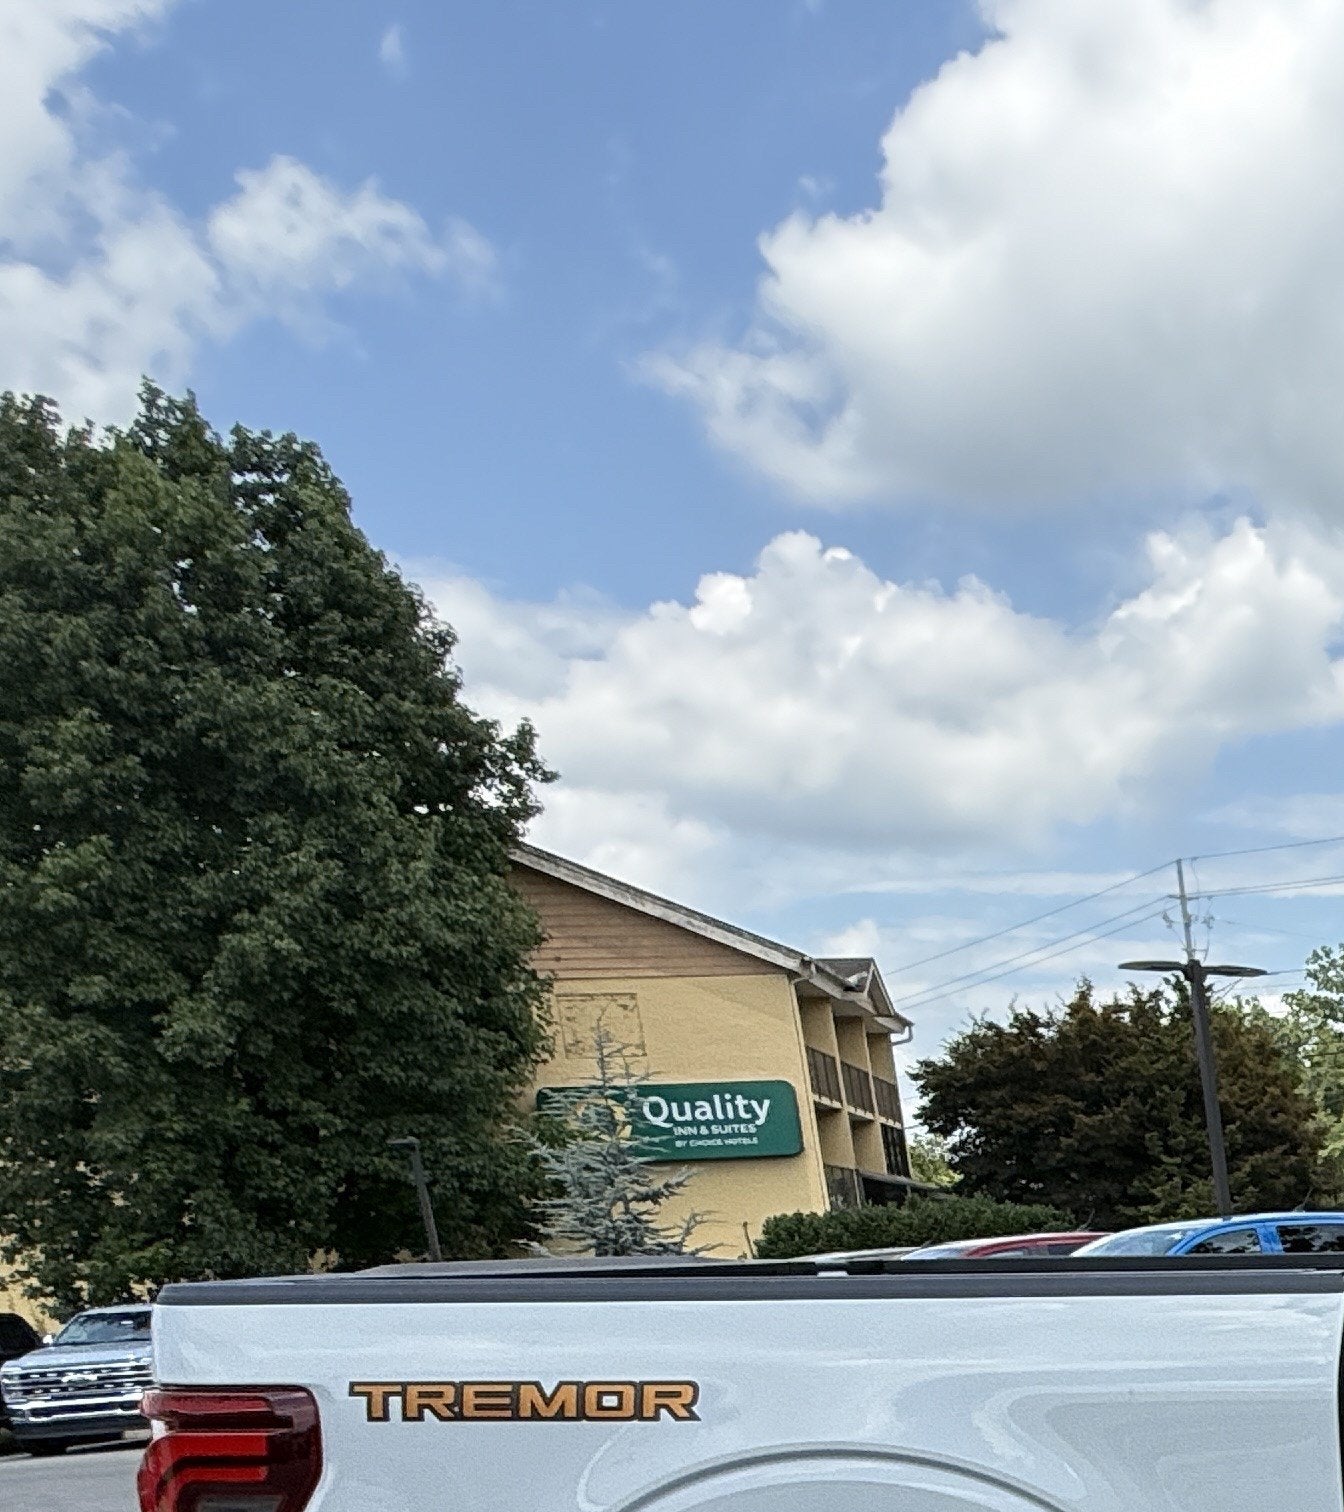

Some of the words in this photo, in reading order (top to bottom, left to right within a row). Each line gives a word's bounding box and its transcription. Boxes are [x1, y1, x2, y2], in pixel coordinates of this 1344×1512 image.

[642, 1093, 771, 1128] Quality
[673, 1125, 697, 1136] INN
[700, 1124, 710, 1136] &
[711, 1123, 757, 1134] SUITES
[348, 1381, 702, 1422] TREMOR
